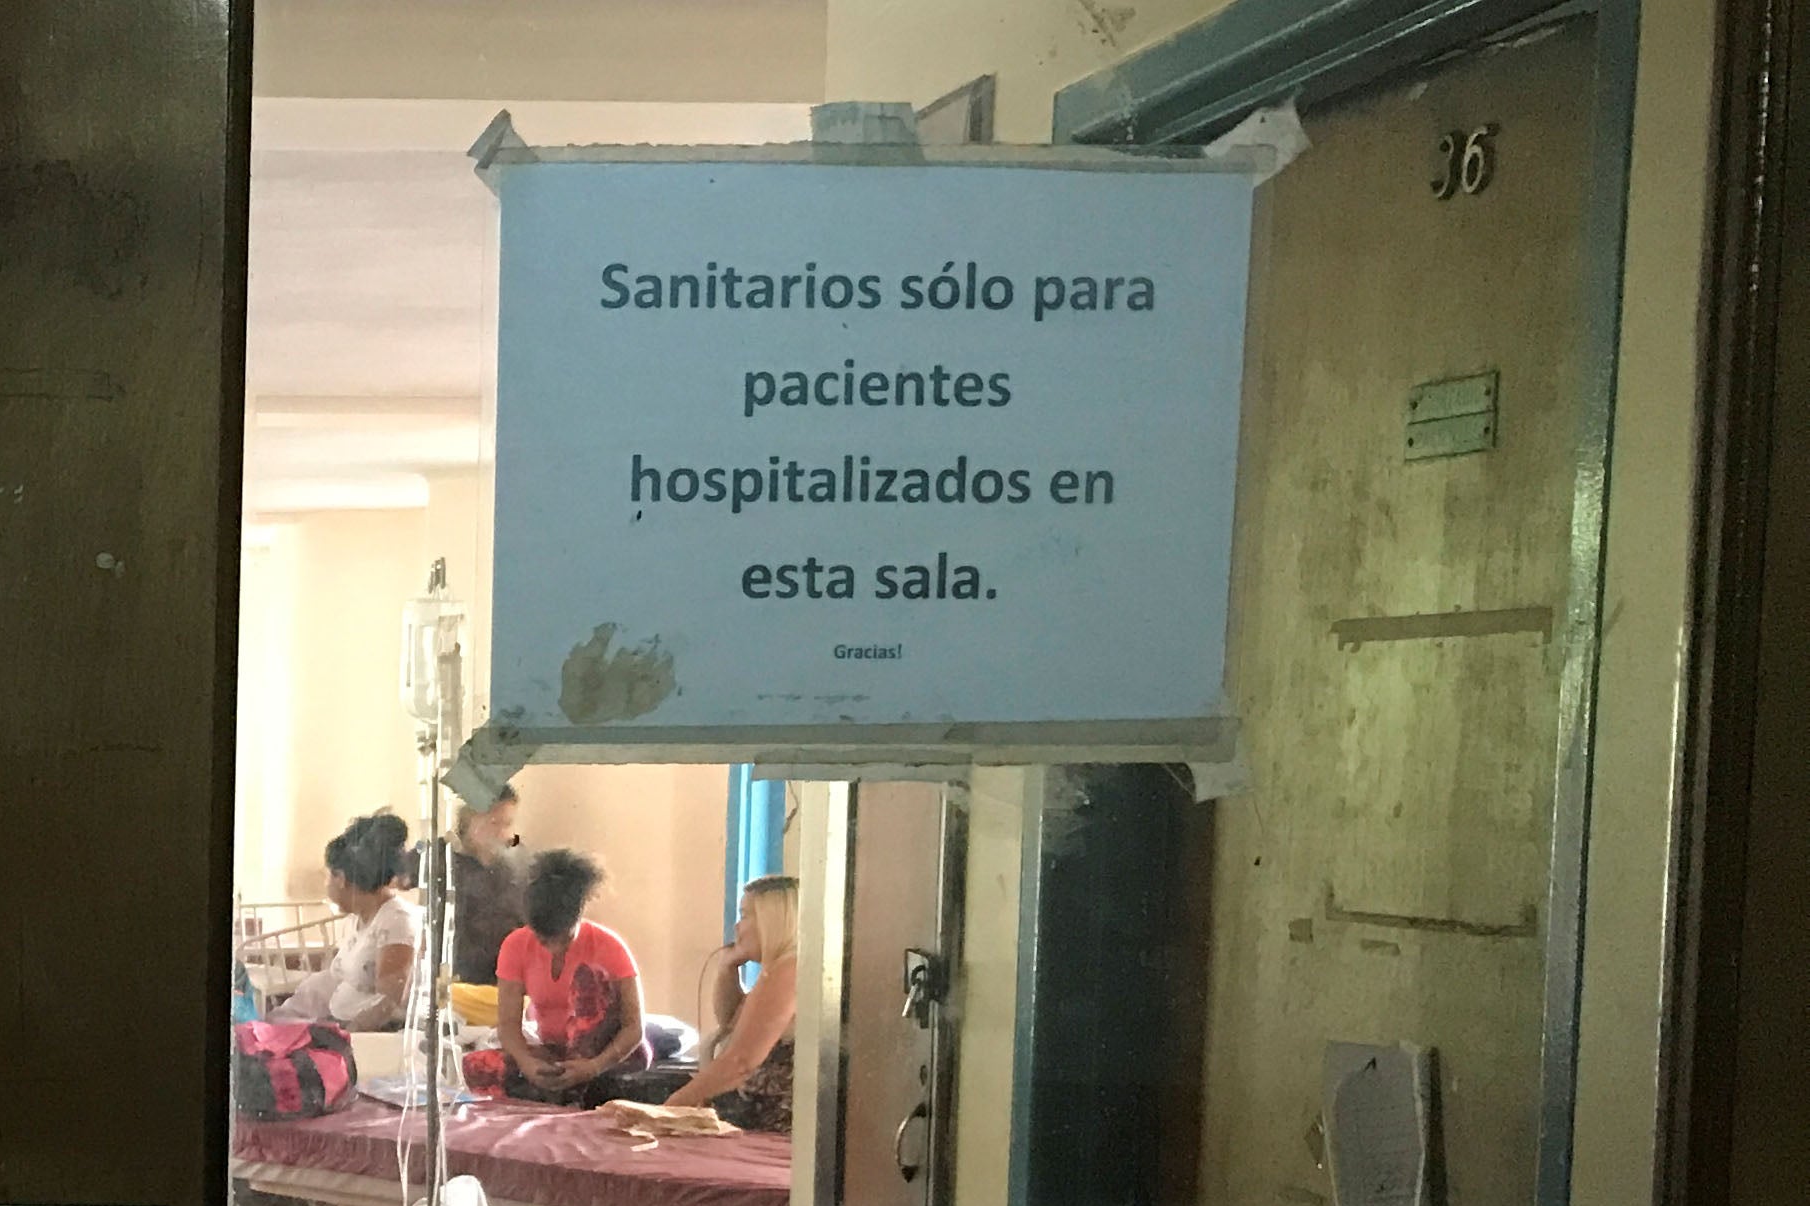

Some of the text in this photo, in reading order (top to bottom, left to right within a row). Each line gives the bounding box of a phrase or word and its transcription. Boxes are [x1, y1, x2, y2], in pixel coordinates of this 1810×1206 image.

[600, 260, 1156, 322] Sanitarios sólo para
[743, 358, 1012, 418] pacientes
[630, 453, 1115, 515] hospitalizados en
[741, 551, 998, 601] esta sala.
[833, 643, 903, 661] Gracias!
